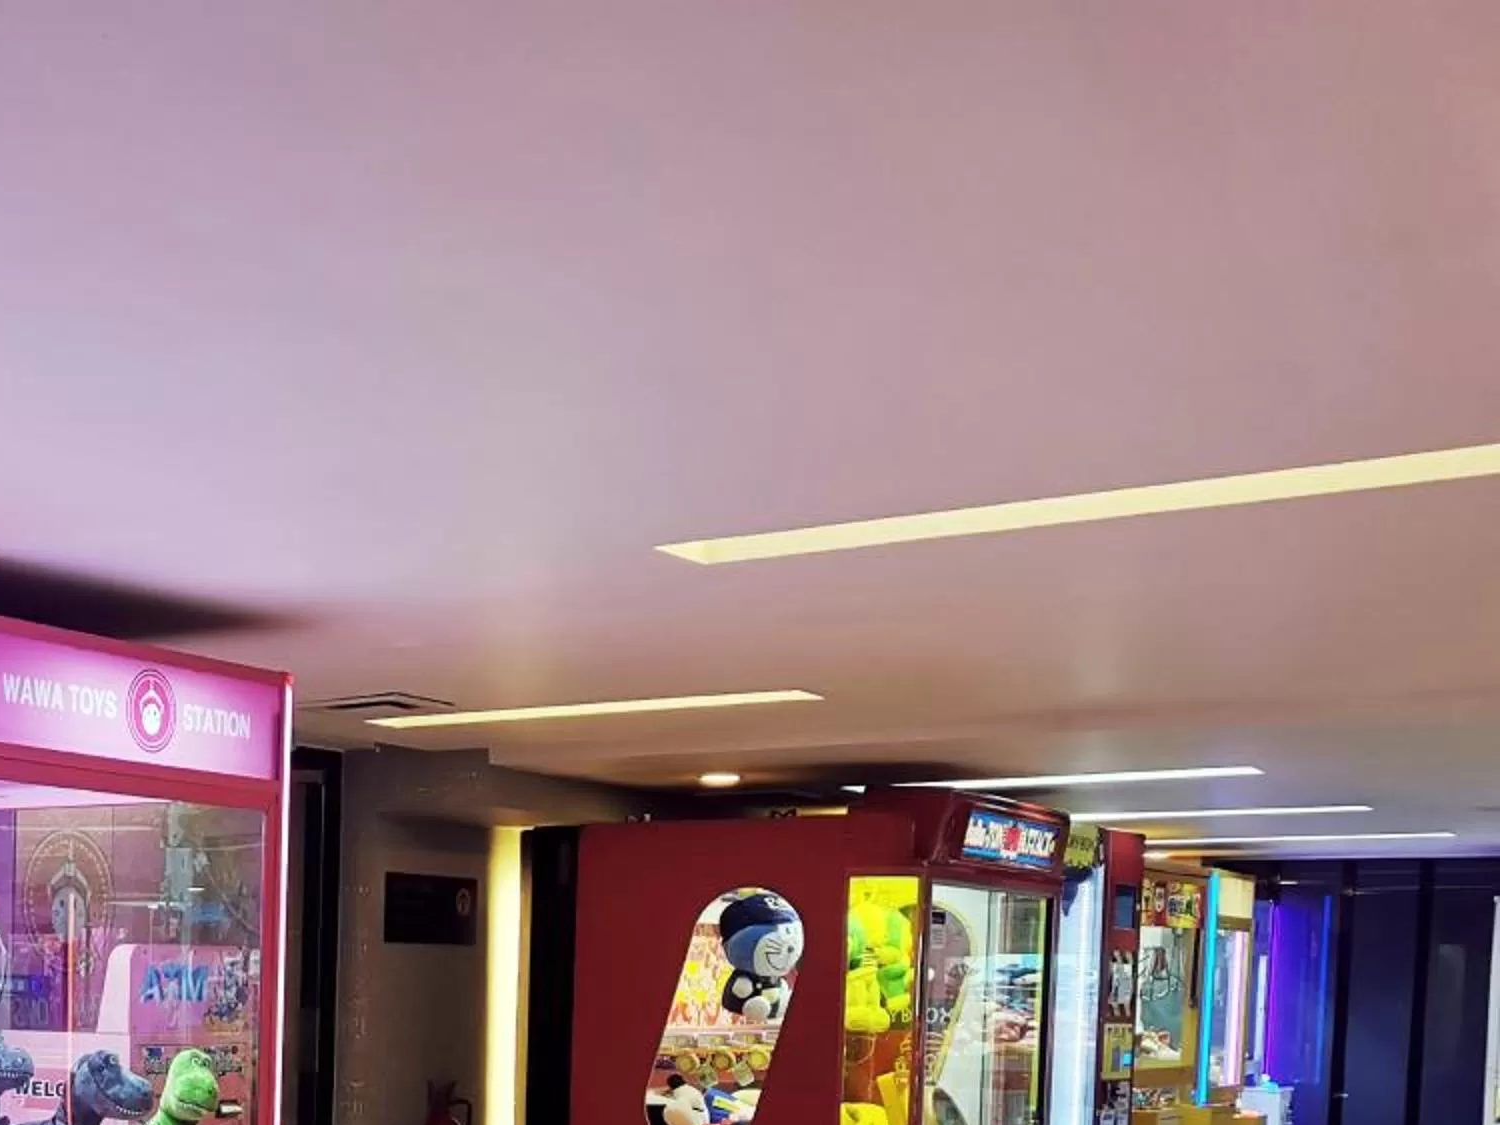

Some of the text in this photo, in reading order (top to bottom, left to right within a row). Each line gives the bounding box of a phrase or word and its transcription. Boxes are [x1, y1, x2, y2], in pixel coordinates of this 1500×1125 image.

[3, 674, 251, 739] WAWA TOYS STATION
[139, 961, 209, 1003] ATM
